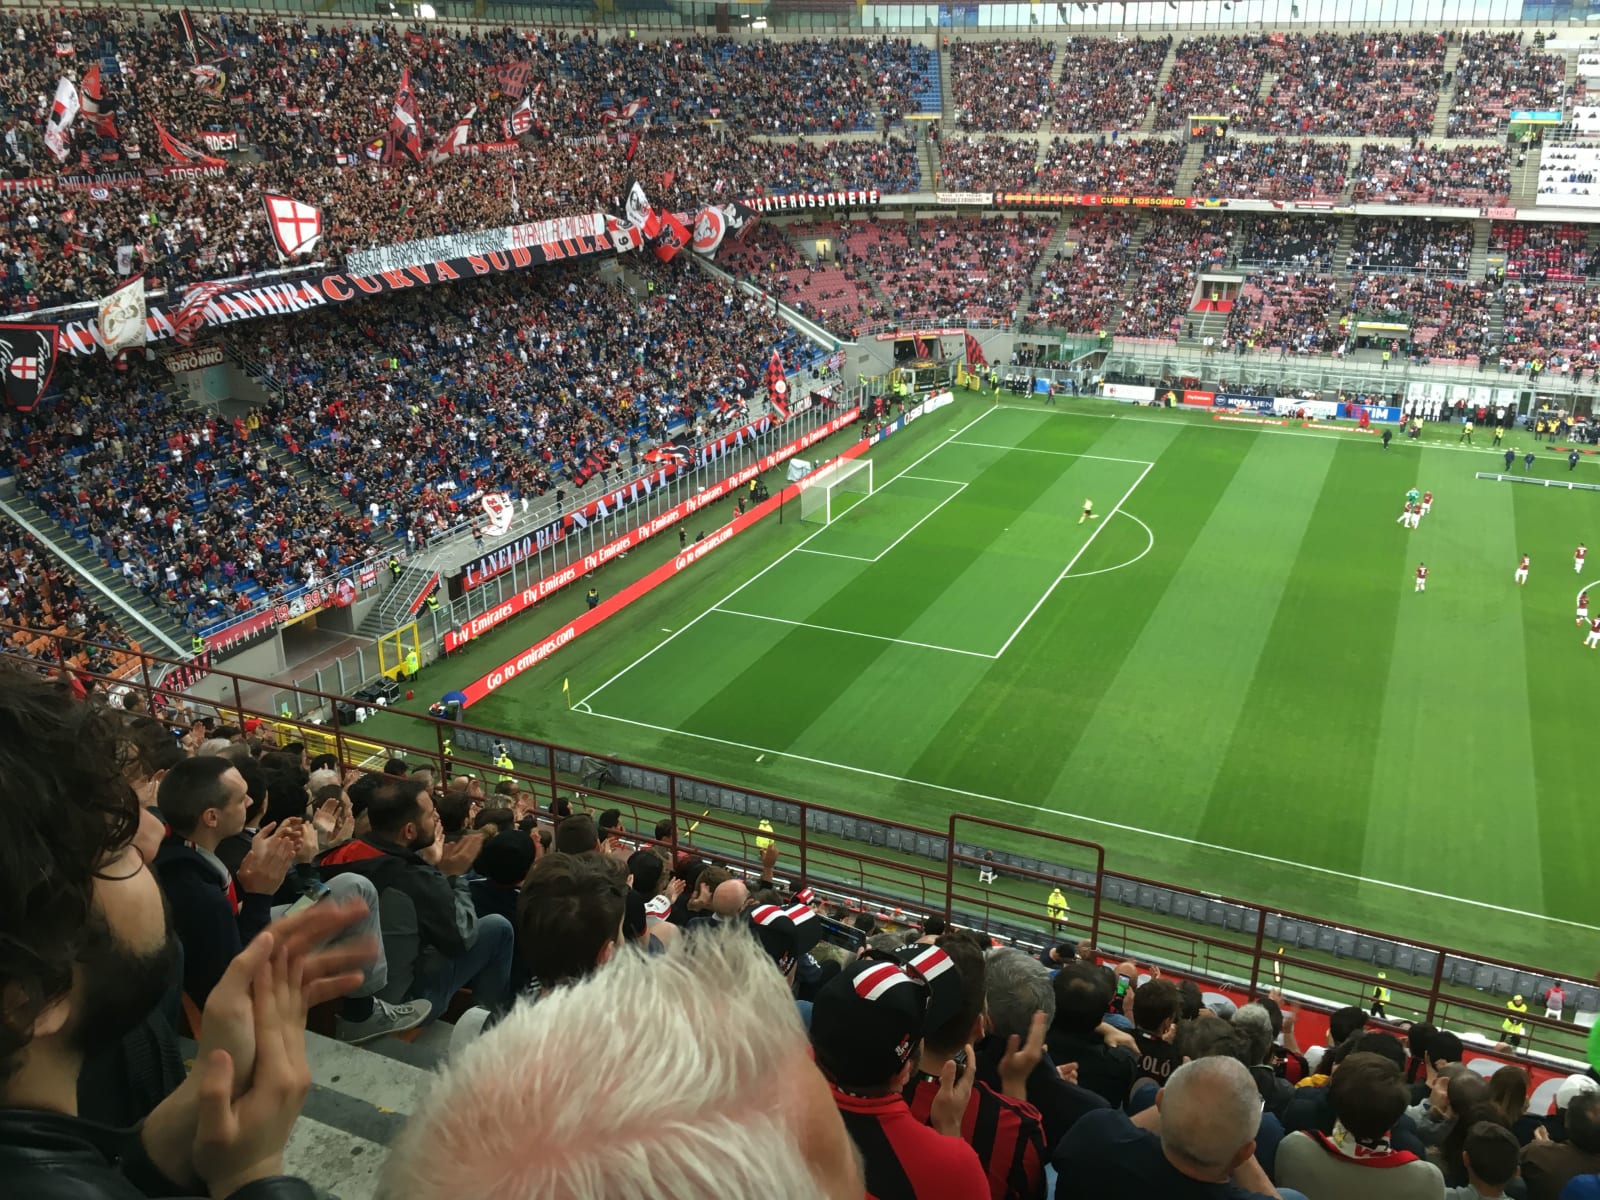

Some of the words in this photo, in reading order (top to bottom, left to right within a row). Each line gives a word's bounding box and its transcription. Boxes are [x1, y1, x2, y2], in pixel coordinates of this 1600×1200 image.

[205, 133, 238, 150] RDEST
[58, 175, 93, 192] EMILIA
[95, 170, 143, 188] ROMAGNA
[170, 166, 225, 181] TOSCANA
[789, 190, 879, 209] ROSSONERE
[1101, 196, 1130, 205] CUORE
[1132, 197, 1186, 206] ROSSONERO
[202, 280, 328, 327] MANIERA
[322, 258, 461, 301] CURVA
[467, 246, 532, 275] SUD
[1228, 398, 1252, 408] NIVEA
[1252, 400, 1273, 409] MEN
[1363, 407, 1389, 420] TIM
[686, 498, 697, 512] Fly
[697, 485, 723, 506] Emirates
[479, 537, 532, 580] ANELLO
[536, 520, 562, 550] BLU
[571, 469, 669, 533] NATIVI
[638, 526, 650, 539] Fly
[651, 510, 680, 528] Emirates
[584, 554, 598, 570] Fly
[599, 537, 630, 562] Emirates
[675, 556, 686, 570] Go
[686, 552, 695, 564] to
[695, 527, 733, 559] emirates.com
[523, 587, 538, 605] Fly
[539, 567, 576, 595] Emirates
[453, 627, 469, 646] Fly
[472, 603, 513, 633] Emirates
[486, 670, 503, 690] Go
[504, 664, 515, 679] to
[516, 626, 575, 670] emirates.com
[1137, 1055, 1171, 1078] OLÓ
